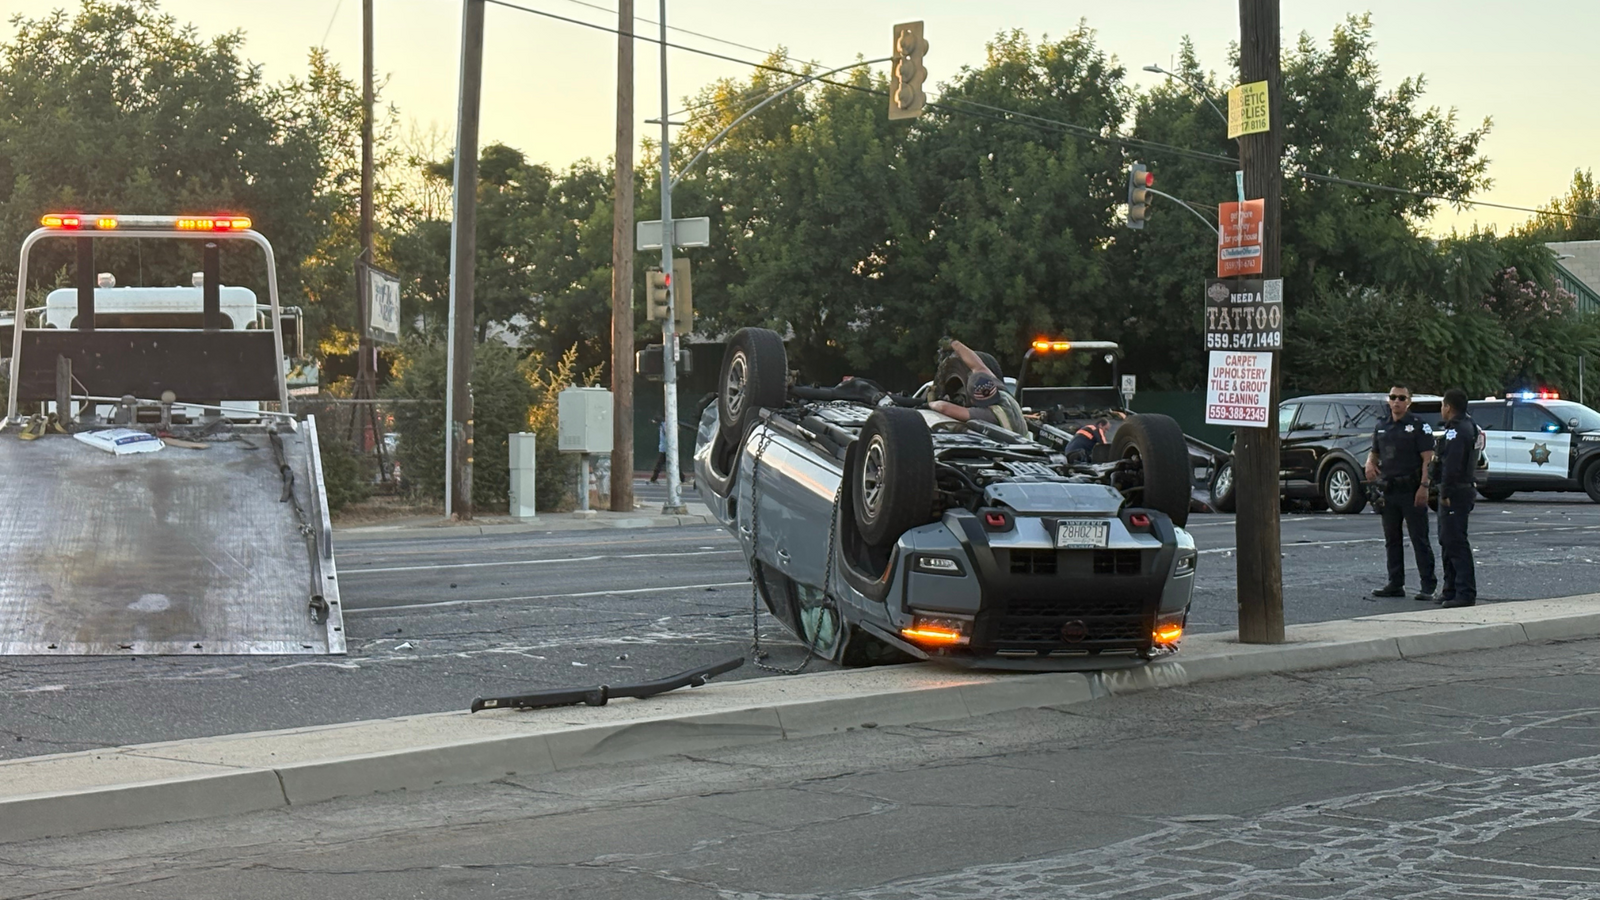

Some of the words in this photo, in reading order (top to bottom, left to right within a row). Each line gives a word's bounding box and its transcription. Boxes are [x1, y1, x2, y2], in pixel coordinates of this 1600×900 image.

[1251, 118, 1266, 129] 8116
[1230, 293, 1253, 303] NEED
[1256, 292, 1261, 302] A
[1206, 305, 1280, 330] TATTOO
[1207, 331, 1280, 348] 559.547.1449
[1225, 355, 1257, 367] CARPET
[1213, 367, 1267, 379] UPHOLSTERY
[1211, 380, 1229, 391] TILE
[1232, 380, 1237, 391] &
[1240, 381, 1267, 392] GROUT
[1218, 392, 1259, 405] CLEANING
[1210, 406, 1265, 420] 559-388-2345
